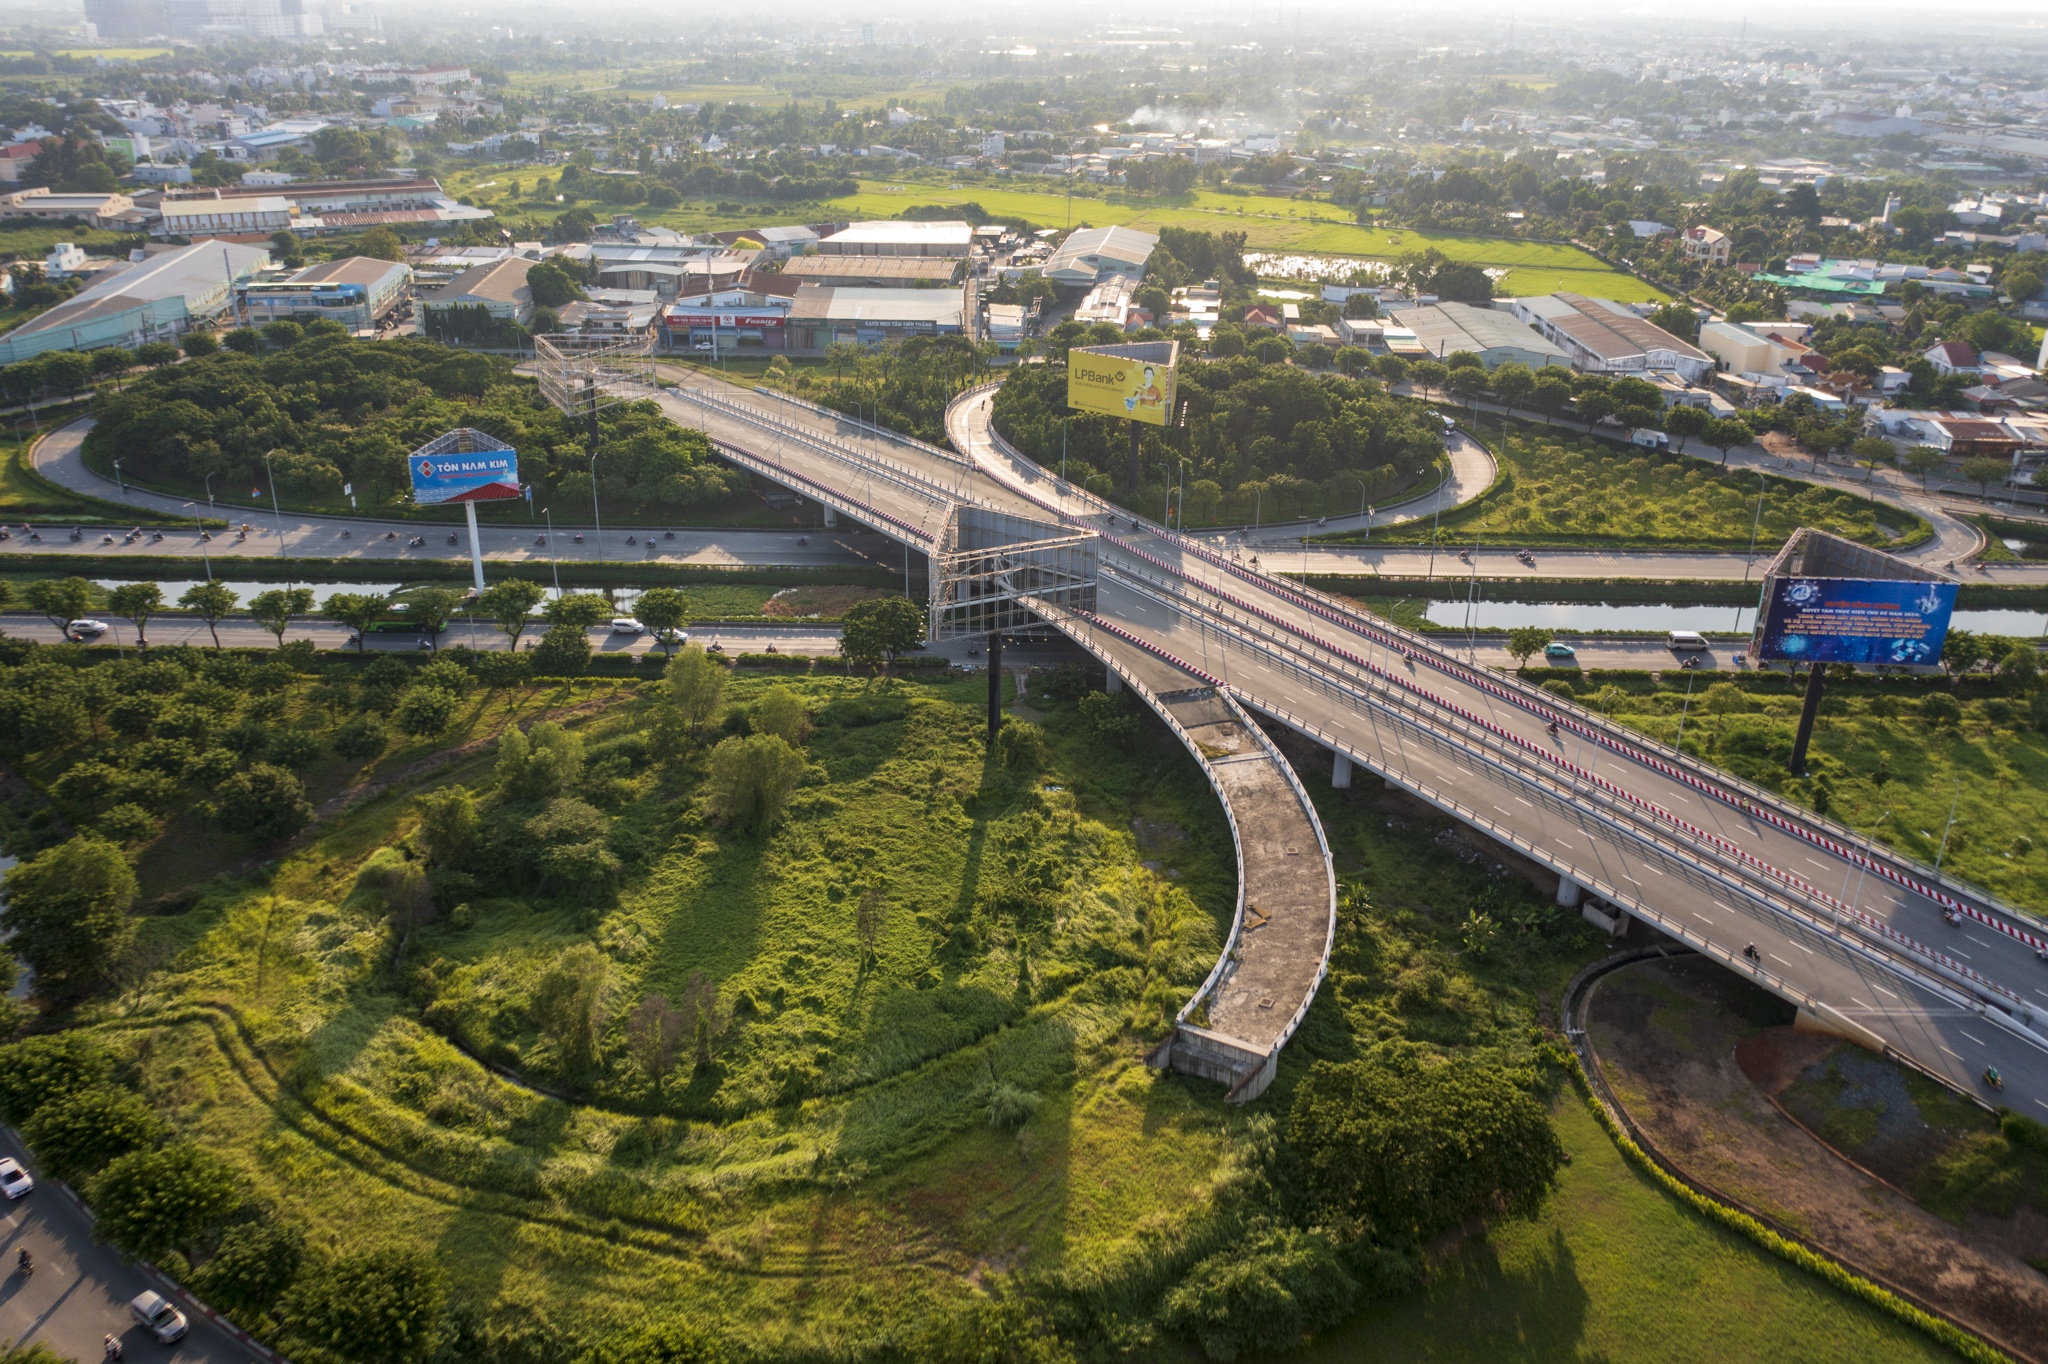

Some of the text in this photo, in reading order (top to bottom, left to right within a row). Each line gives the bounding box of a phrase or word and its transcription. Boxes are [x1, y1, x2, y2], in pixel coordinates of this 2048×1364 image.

[1075, 368, 1114, 385] LPBank
[437, 459, 508, 473] TÔN NAM KIM
